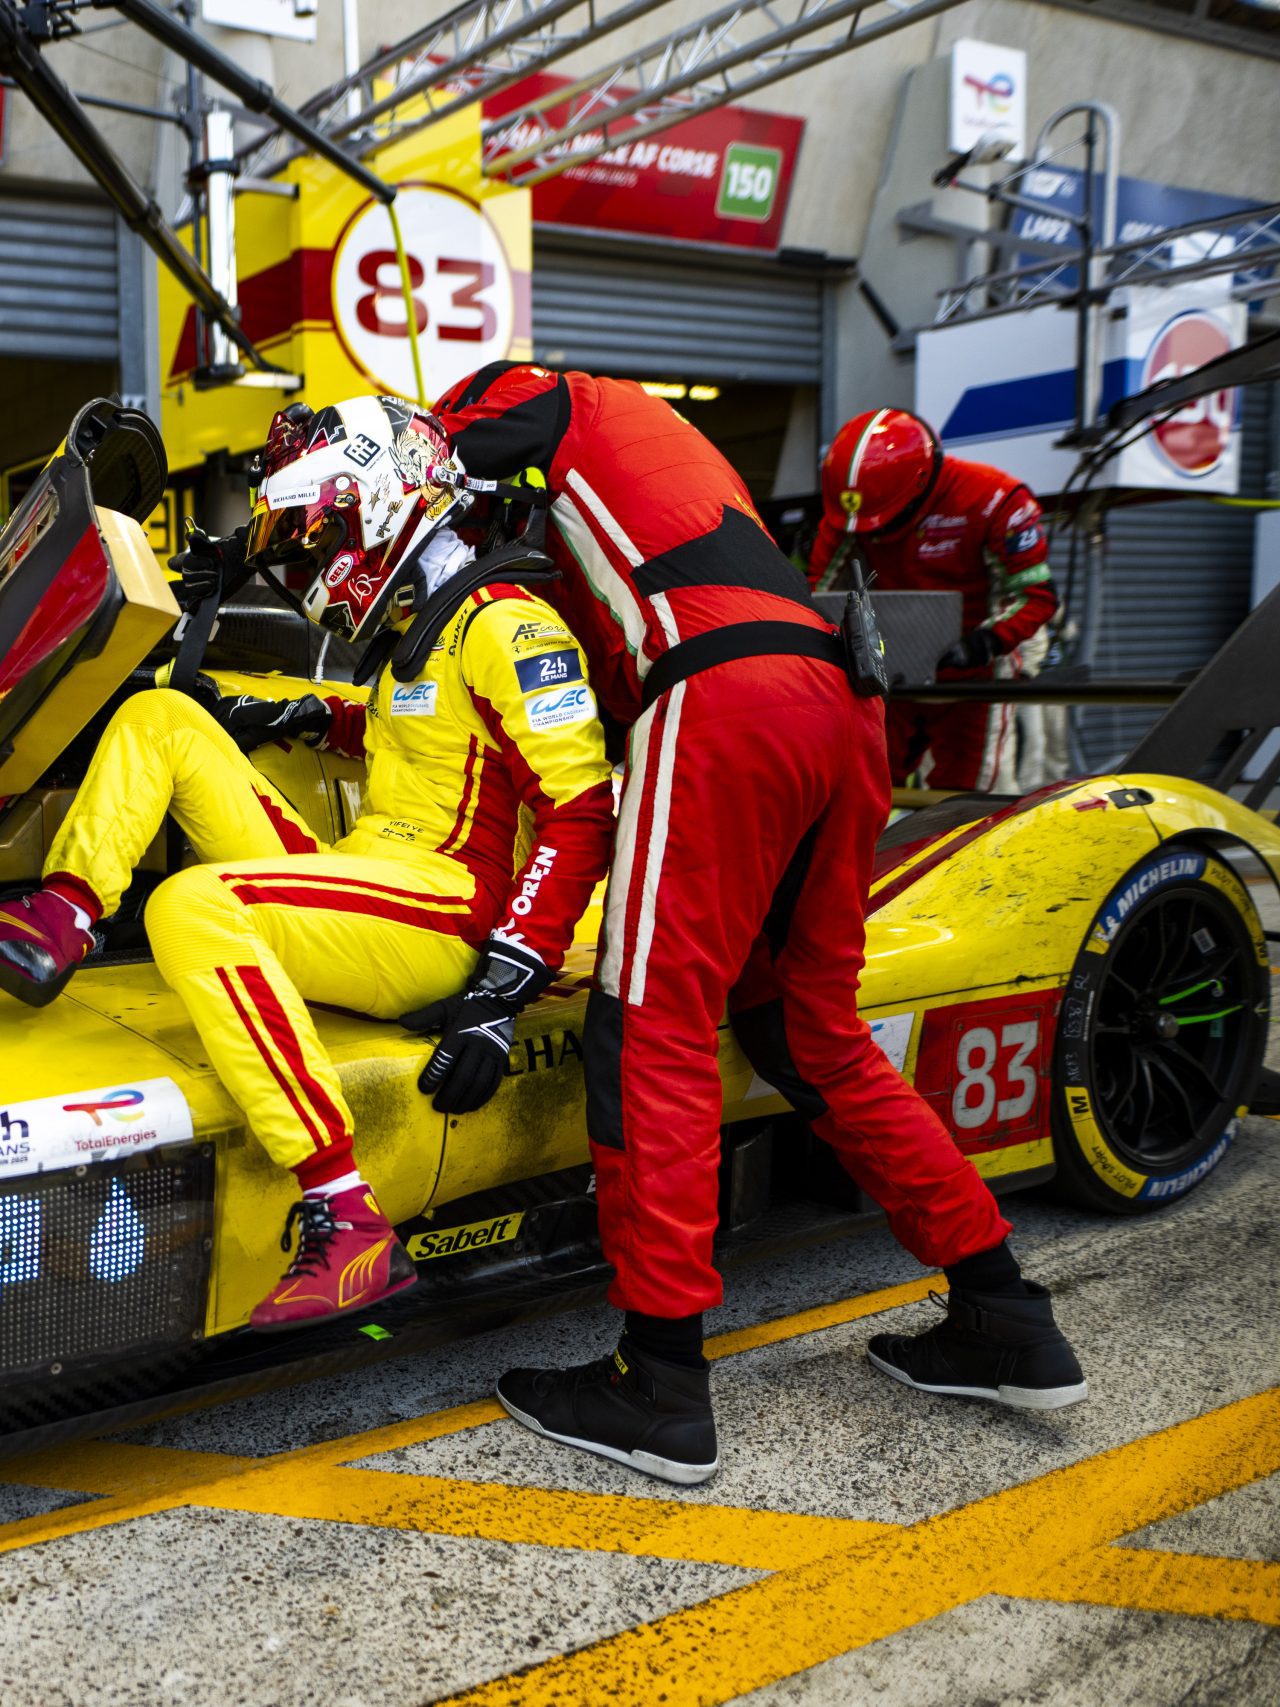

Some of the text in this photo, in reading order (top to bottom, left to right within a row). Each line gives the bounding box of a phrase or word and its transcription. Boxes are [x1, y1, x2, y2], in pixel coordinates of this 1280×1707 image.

[656, 146, 719, 178] CORSE
[726, 161, 773, 203] 150
[355, 249, 498, 343] 83
[273, 494, 297, 503] RICHARD
[328, 560, 350, 583] BELL
[539, 656, 568, 677] 24h
[550, 672, 568, 680] MANS
[393, 684, 436, 702] WEC
[531, 688, 587, 716] WEC
[533, 715, 575, 728] CHAMPIONSHIP
[542, 712, 563, 721] WORLD
[390, 821, 425, 833] YIFEI YE
[1117, 858, 1199, 918] MICHELIN
[952, 1019, 1039, 1130] 83
[1071, 1095, 1089, 1114] M
[75, 1129, 158, 1151] TotalEnergies
[1091, 1145, 1117, 1176] SPORT
[415, 1216, 512, 1258] Sabelt
